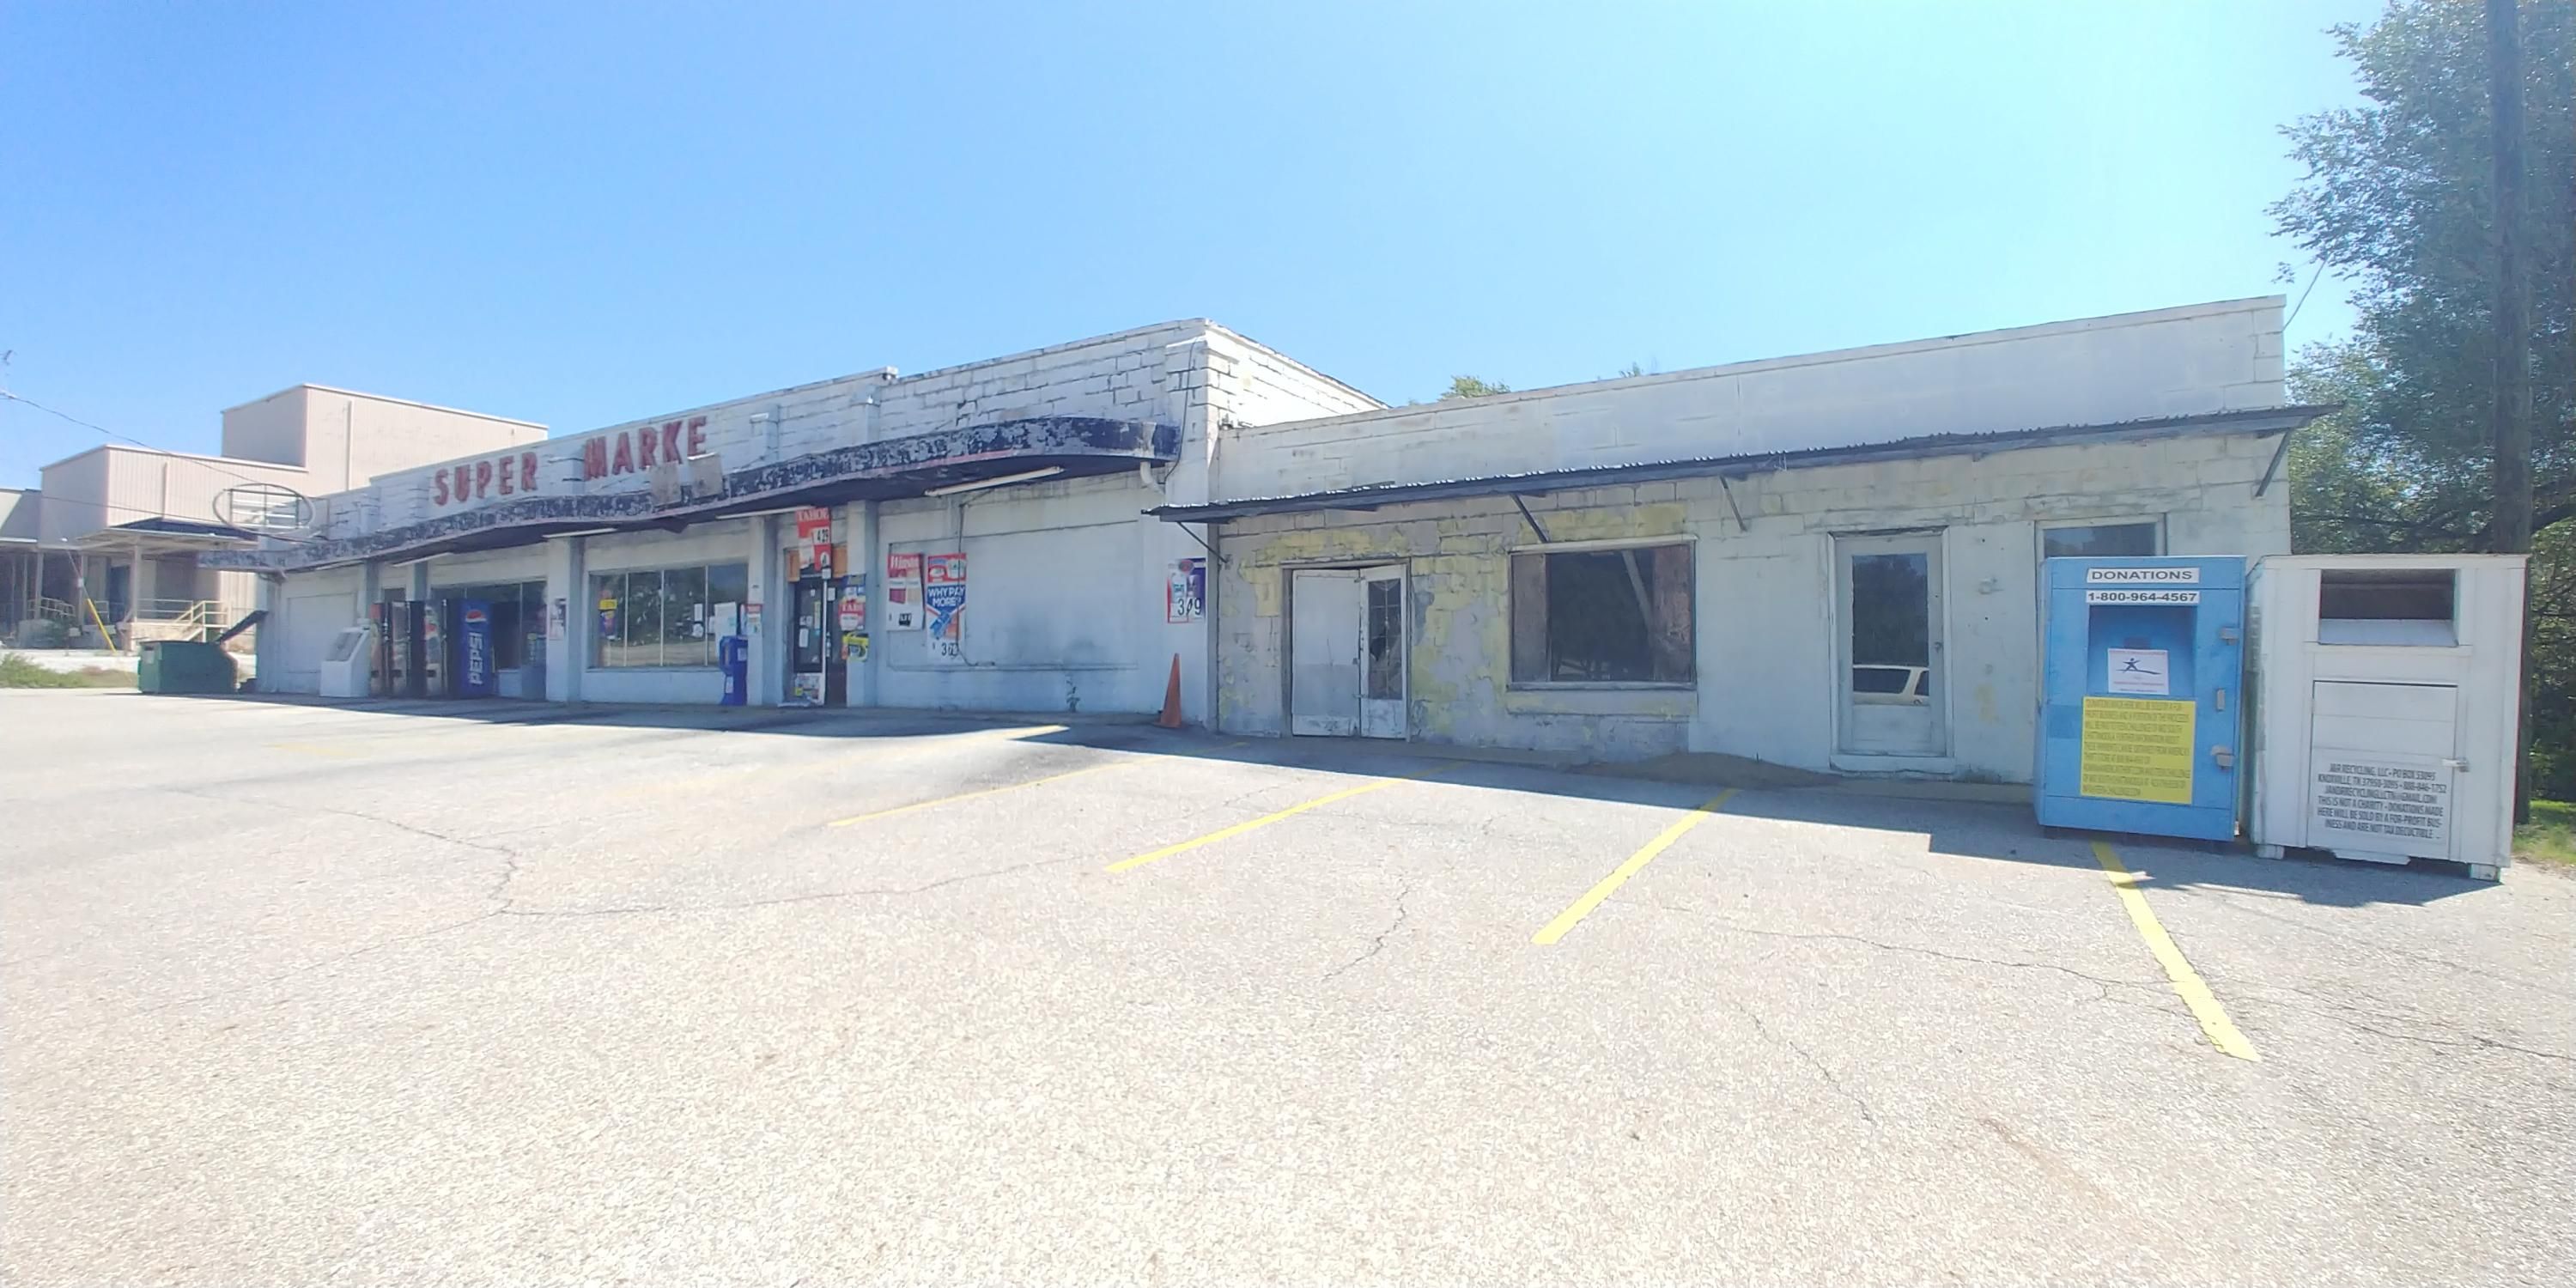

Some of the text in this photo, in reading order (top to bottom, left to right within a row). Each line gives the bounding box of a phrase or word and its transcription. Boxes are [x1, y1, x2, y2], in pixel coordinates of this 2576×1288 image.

[434, 416, 708, 507] SUPER MARKE
[2091, 570, 2192, 580] DONATIONS
[928, 586, 966, 598] WHY PAY
[2087, 592, 2197, 603] 1-800-964-4567
[933, 597, 963, 607] MORE?
[469, 632, 483, 685] PEPSI
[2318, 806, 2334, 817] HERE
[2358, 811, 2373, 822] SOLD
[2340, 797, 2352, 807] NOT
[2388, 802, 2425, 815] DONATIONS
[2425, 805, 2444, 817] MADE
